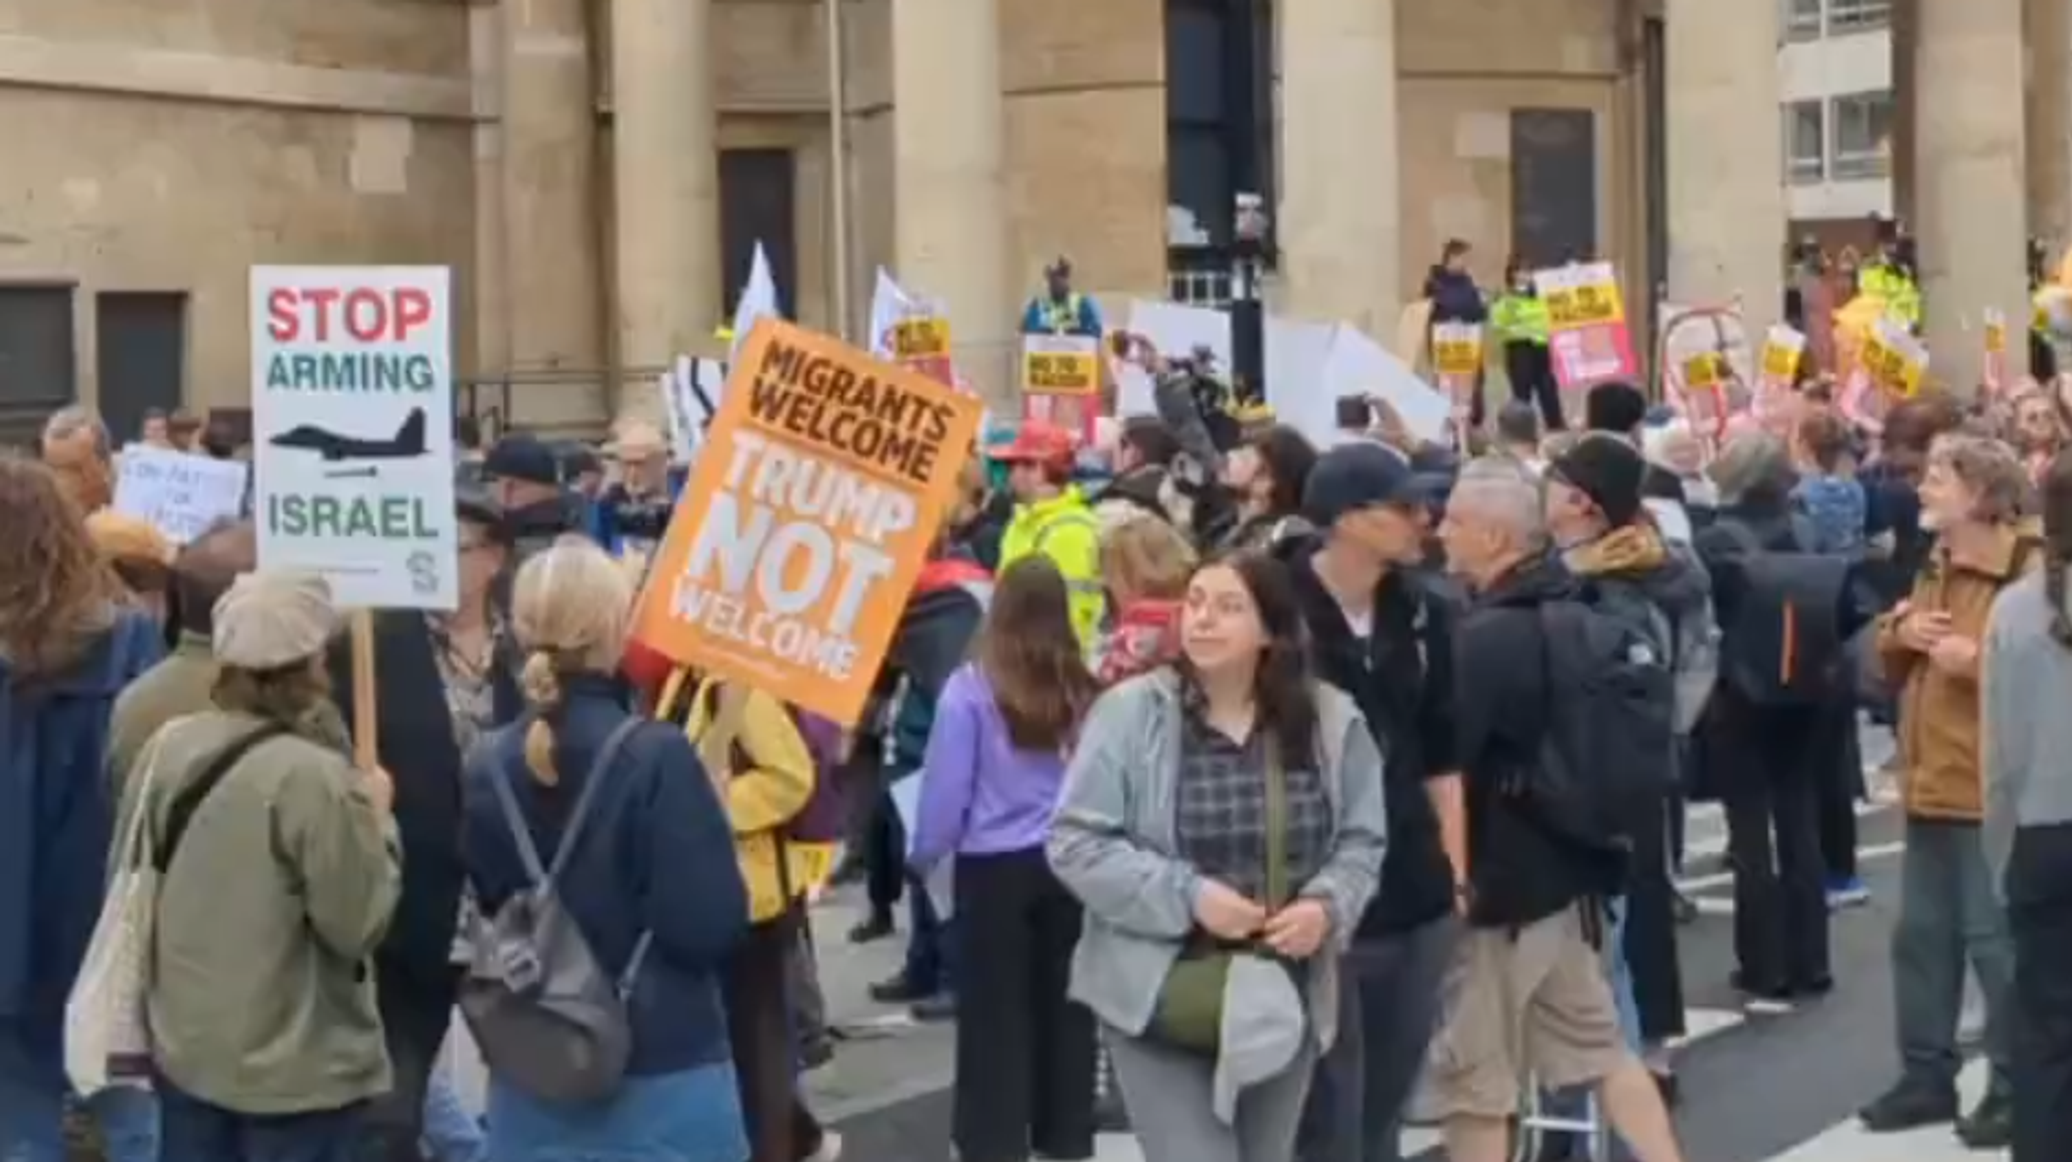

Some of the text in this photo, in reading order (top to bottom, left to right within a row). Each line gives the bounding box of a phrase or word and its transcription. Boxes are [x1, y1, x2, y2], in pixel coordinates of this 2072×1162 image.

[267, 287, 432, 342] STOP
[267, 353, 434, 391] ARMING
[761, 339, 955, 443] MIGRANTS
[749, 377, 940, 483] WELCOME
[269, 493, 439, 538] ISRAEL
[723, 429, 917, 542] TRUMP
[686, 490, 894, 638] NOT
[668, 575, 860, 681] WELCOME
